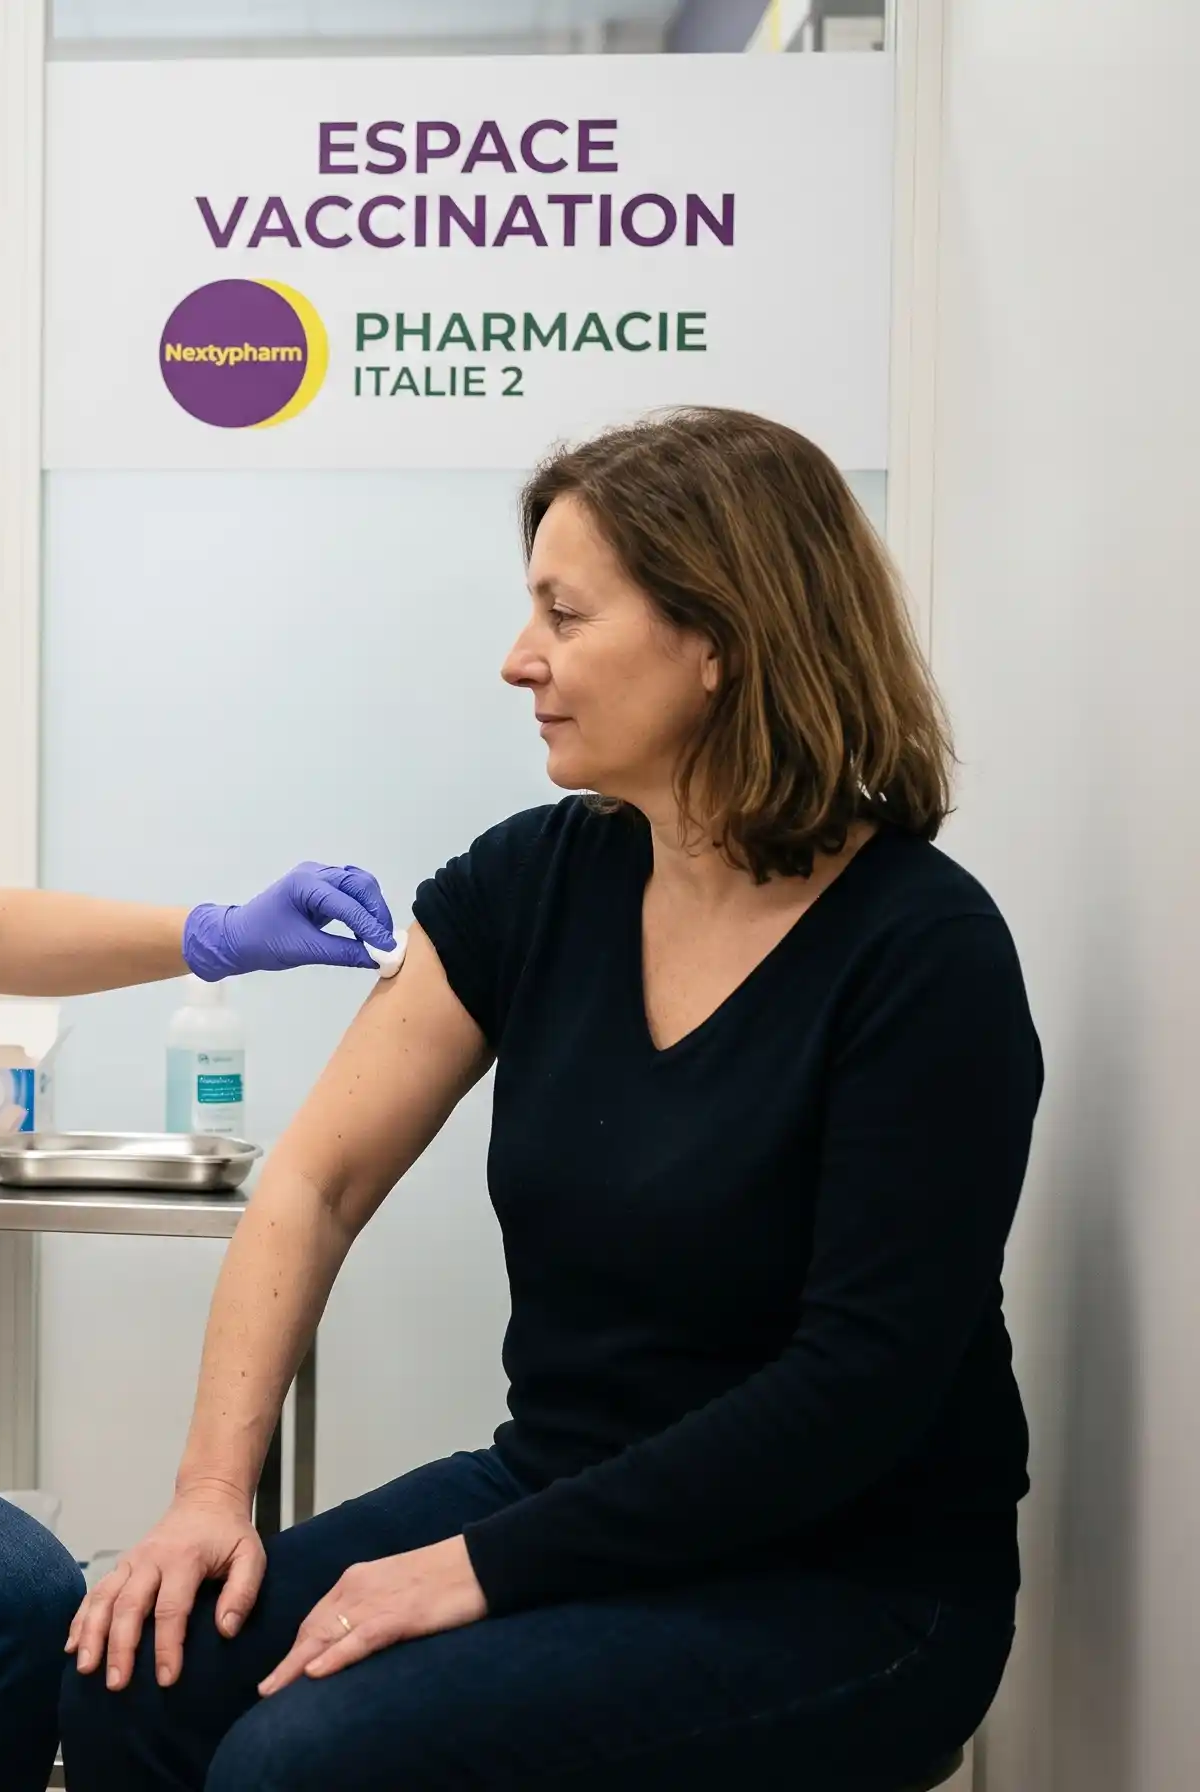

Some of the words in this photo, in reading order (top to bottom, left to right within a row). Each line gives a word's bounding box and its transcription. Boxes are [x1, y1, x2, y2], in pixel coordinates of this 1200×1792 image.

[318, 119, 619, 175] ESPACE
[195, 192, 735, 249] VACCINATION
[356, 311, 707, 352] PHARMACIE
[164, 342, 303, 367] Nextypharm
[354, 366, 487, 397] ITALIE
[501, 366, 524, 397] 2
